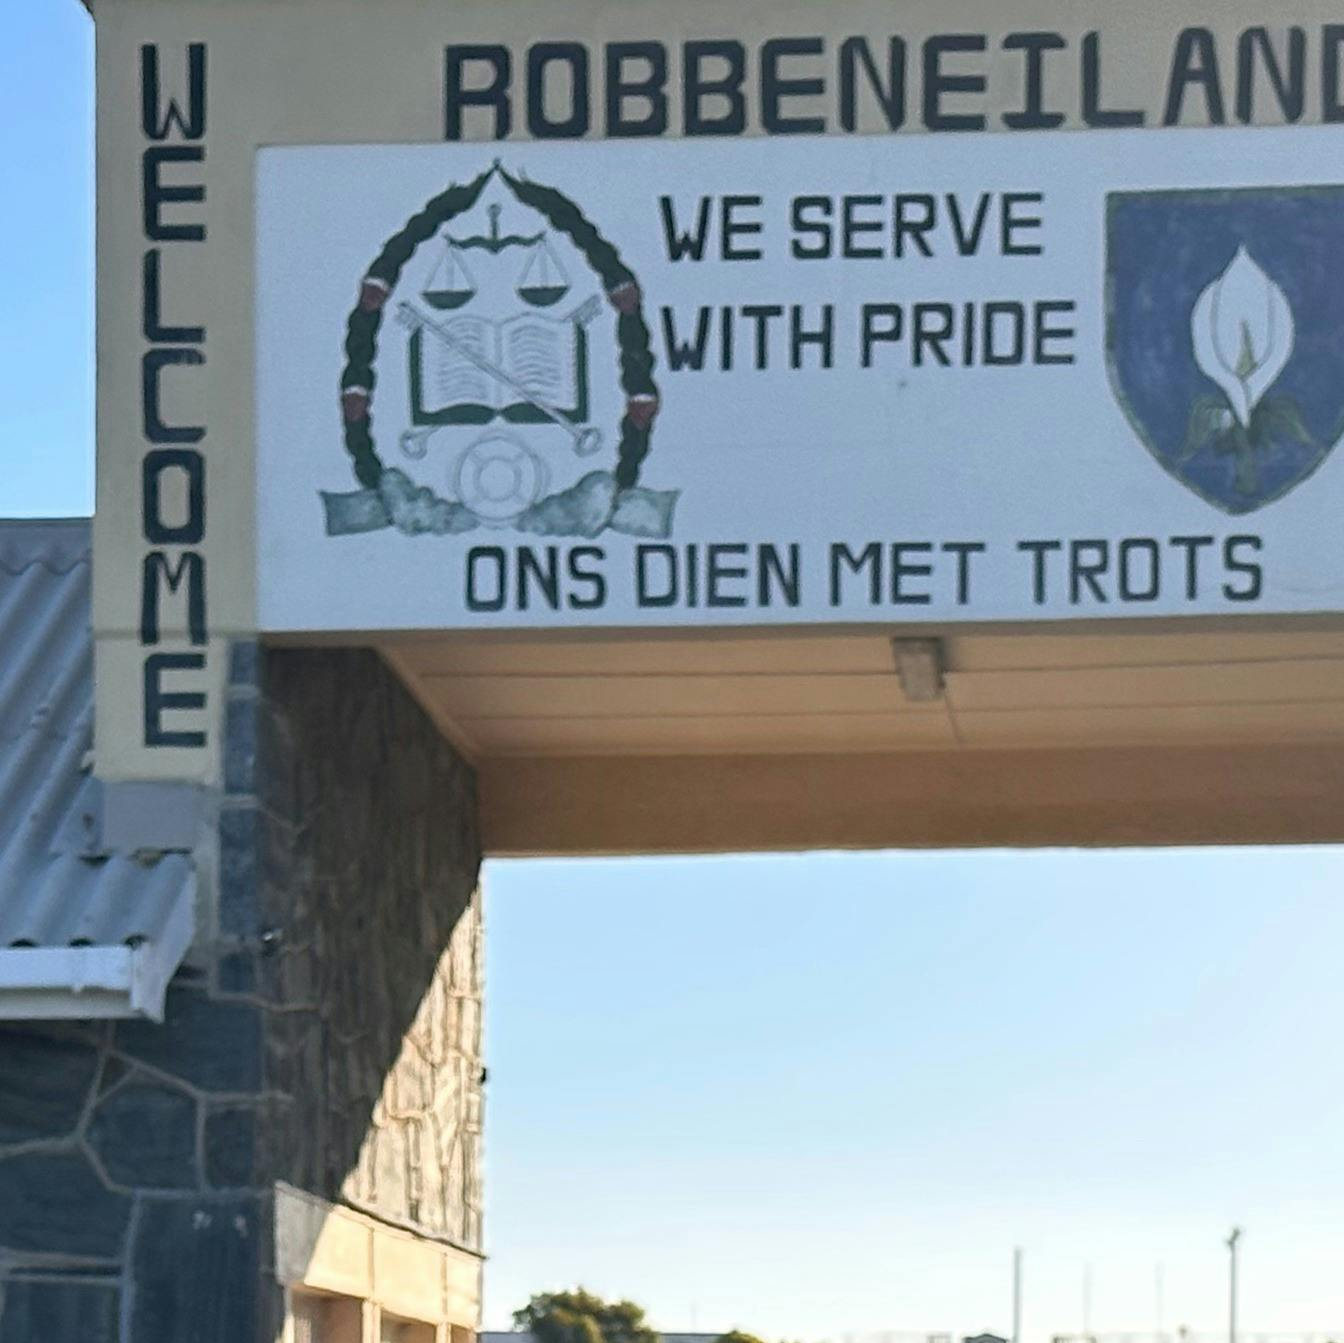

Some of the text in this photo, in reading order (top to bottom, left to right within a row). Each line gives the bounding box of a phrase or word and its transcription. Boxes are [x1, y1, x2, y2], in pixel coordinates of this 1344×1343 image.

[659, 192, 1044, 263] WE SERVE
[661, 300, 1076, 372] WITH PRIDE
[139, 42, 209, 748] WELCOME
[464, 534, 1264, 614] ONS DIEN MET TROTS
